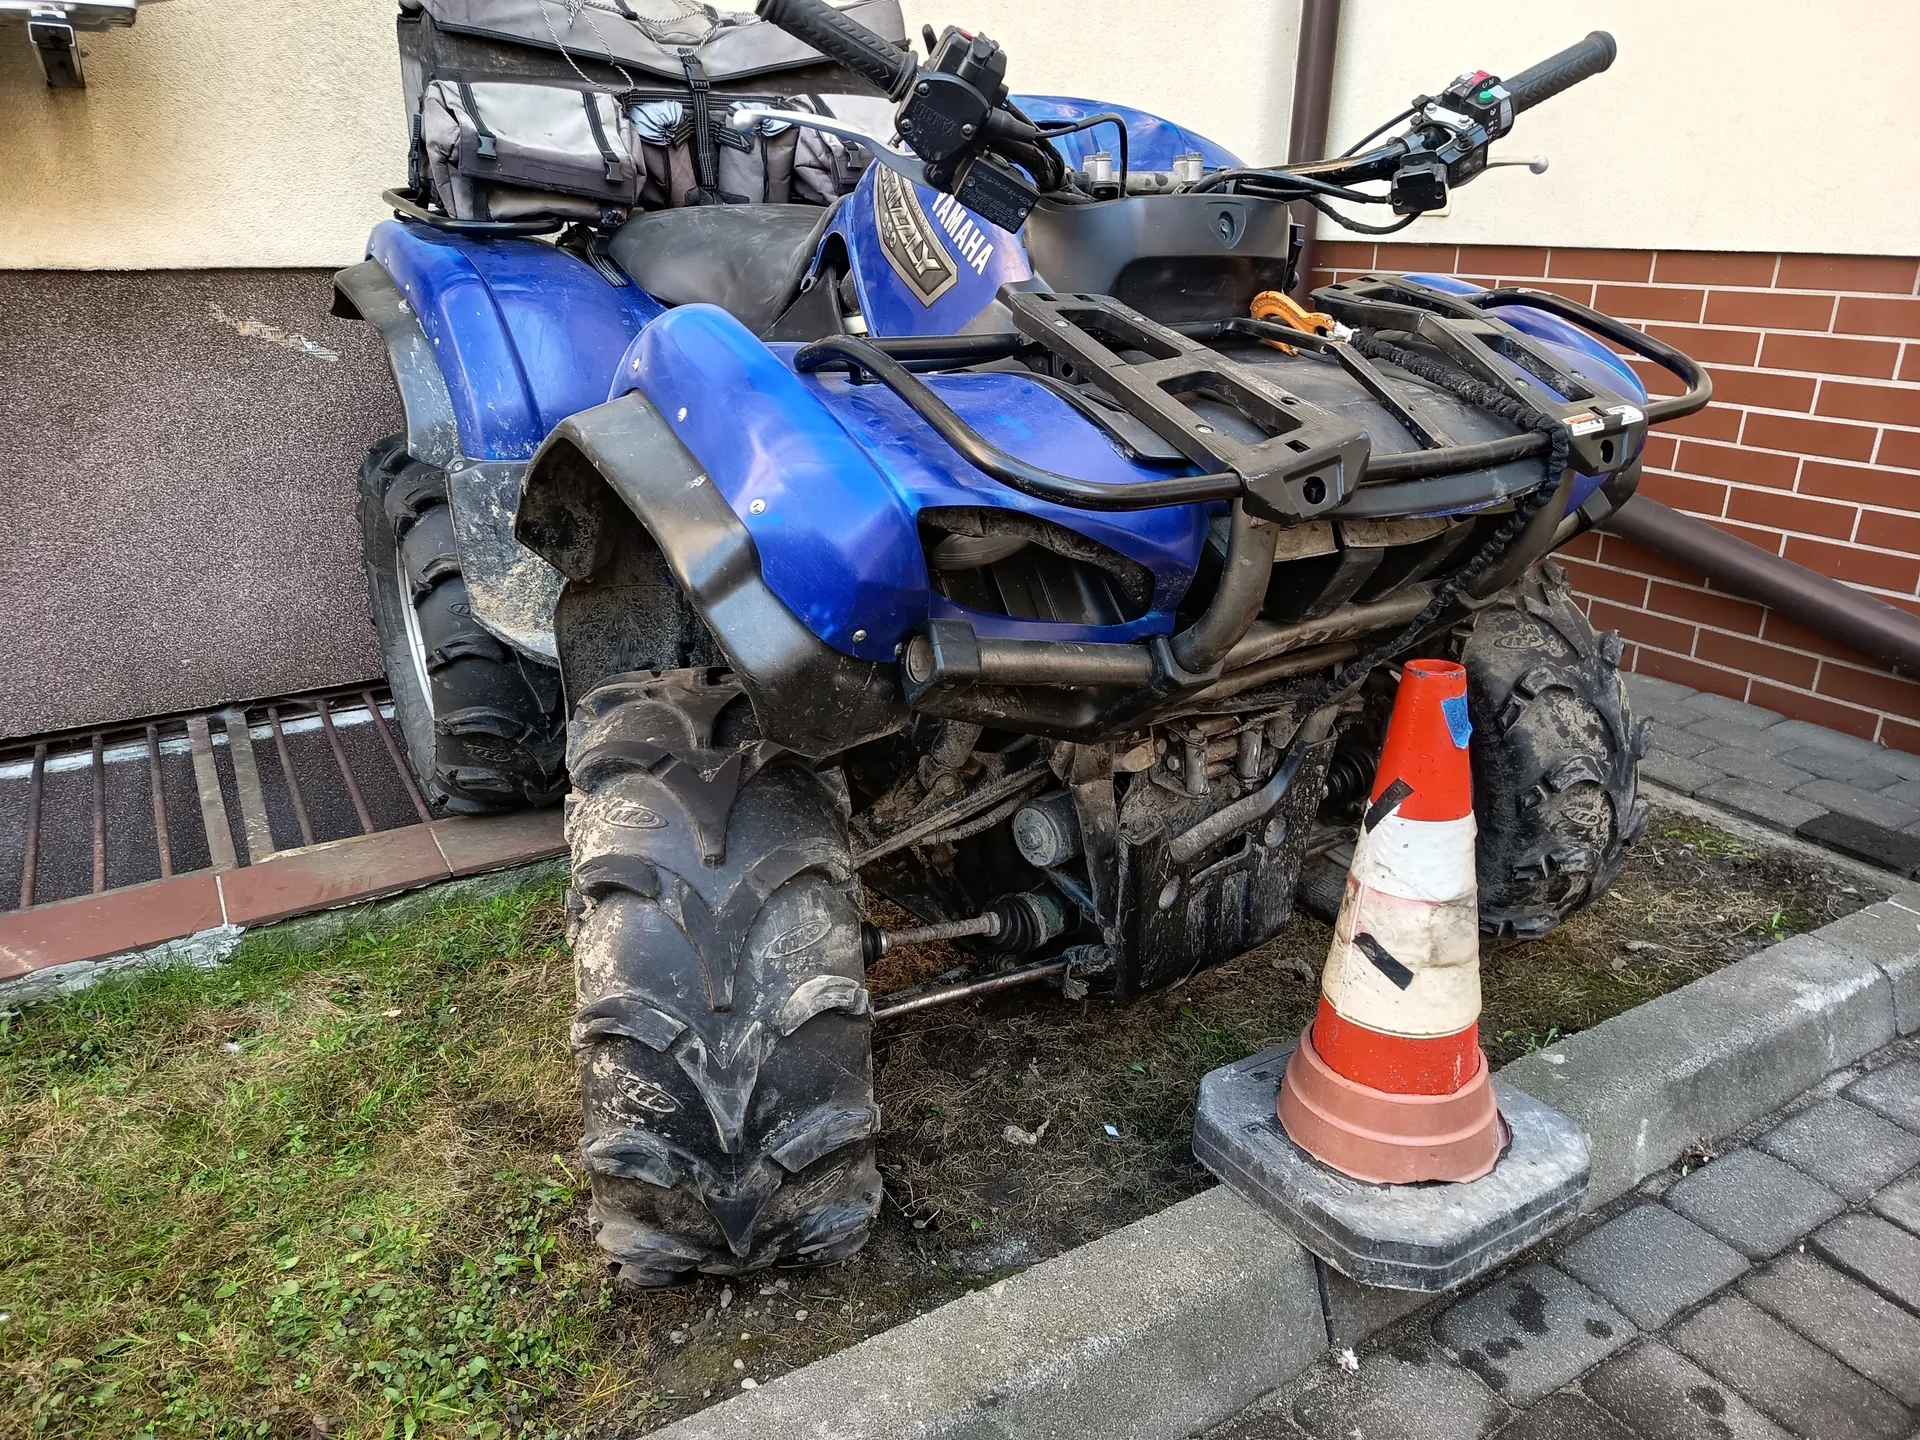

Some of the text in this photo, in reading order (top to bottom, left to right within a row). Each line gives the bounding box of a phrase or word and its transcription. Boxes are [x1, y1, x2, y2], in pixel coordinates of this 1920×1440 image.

[931, 192, 995, 276] YAMAHA
[609, 809, 655, 825] ITP
[1570, 811, 1598, 823] ITP
[621, 1082, 675, 1110] ITP
